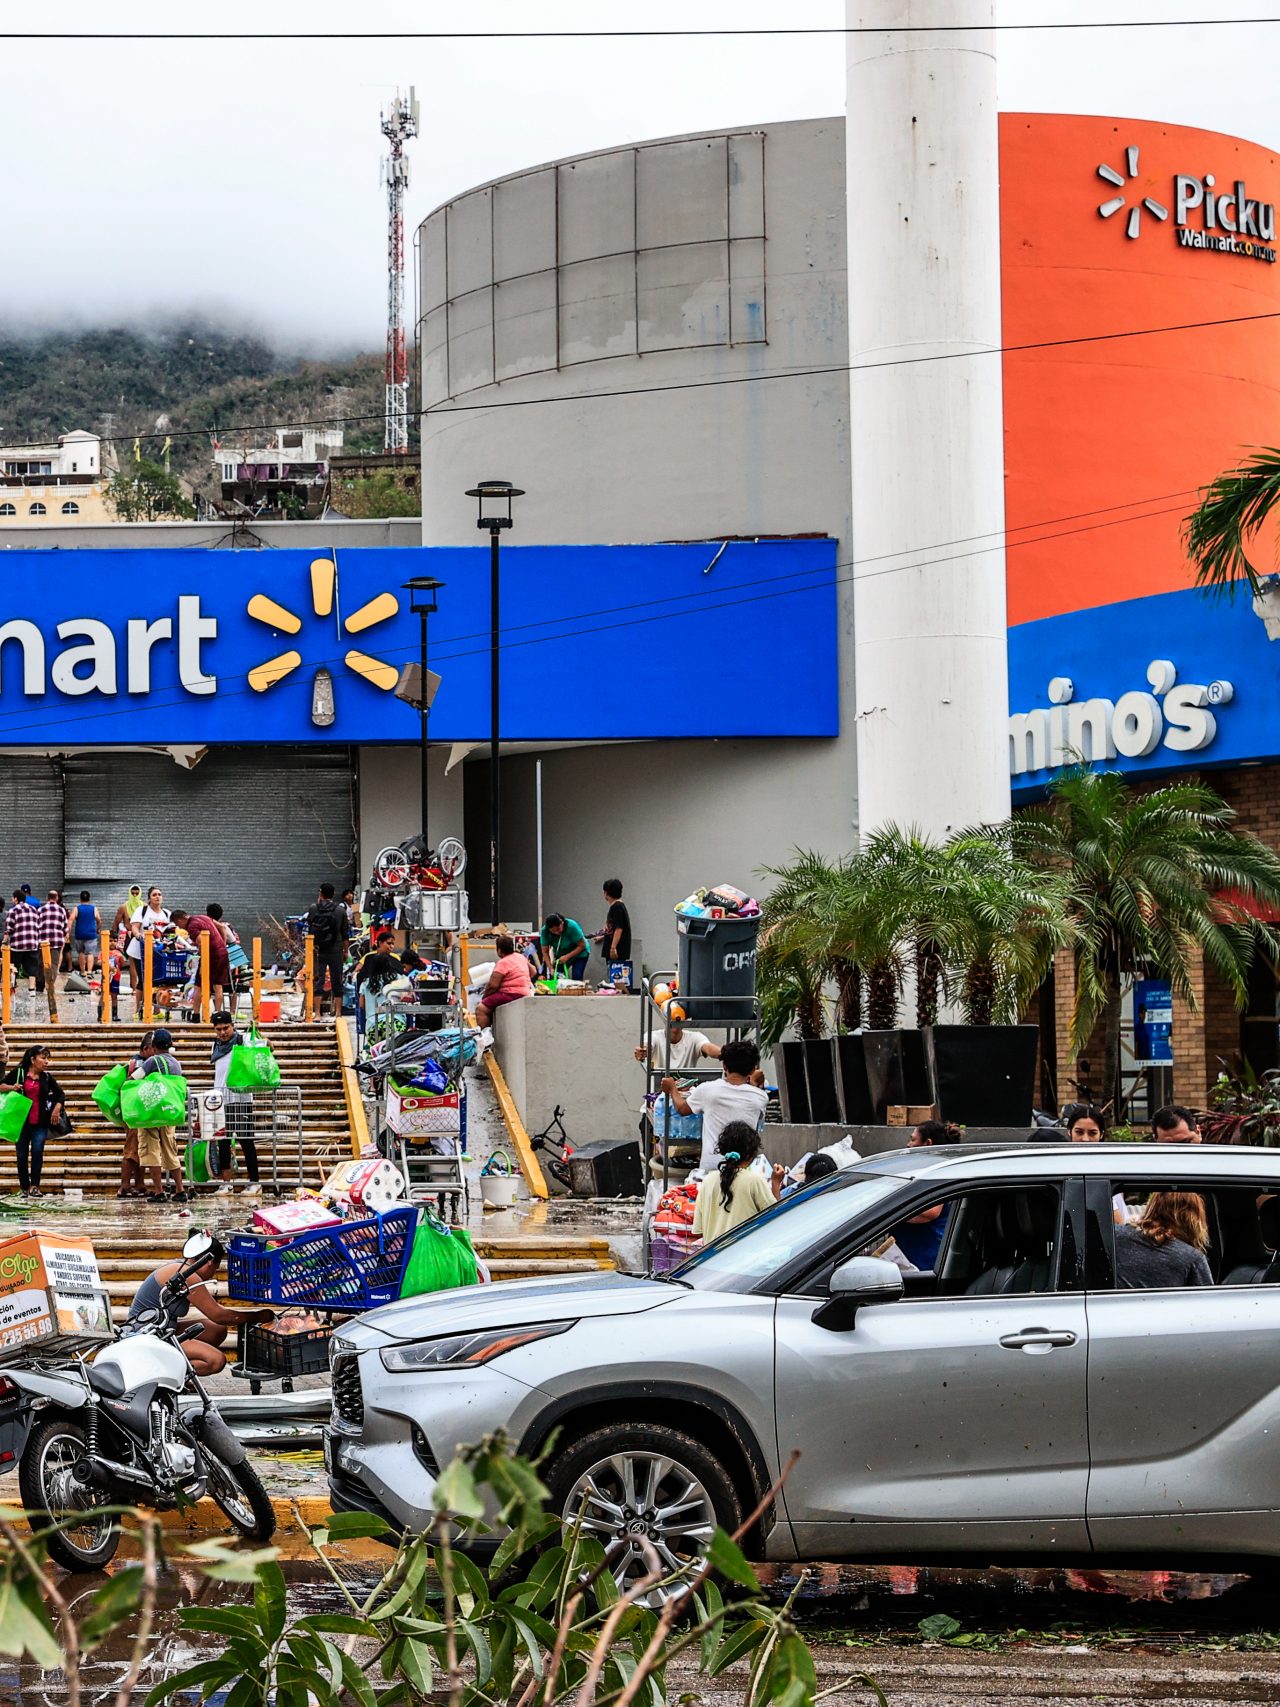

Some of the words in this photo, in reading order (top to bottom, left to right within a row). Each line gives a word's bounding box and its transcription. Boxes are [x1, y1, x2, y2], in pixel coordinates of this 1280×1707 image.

[1174, 173, 1277, 241] Picku
[0, 1253, 39, 1282] Olga
[2, 1315, 12, 1324] de
[13, 1306, 42, 1320] eventos
[1, 1328, 23, 1347] 235
[37, 1317, 53, 1335] 98
